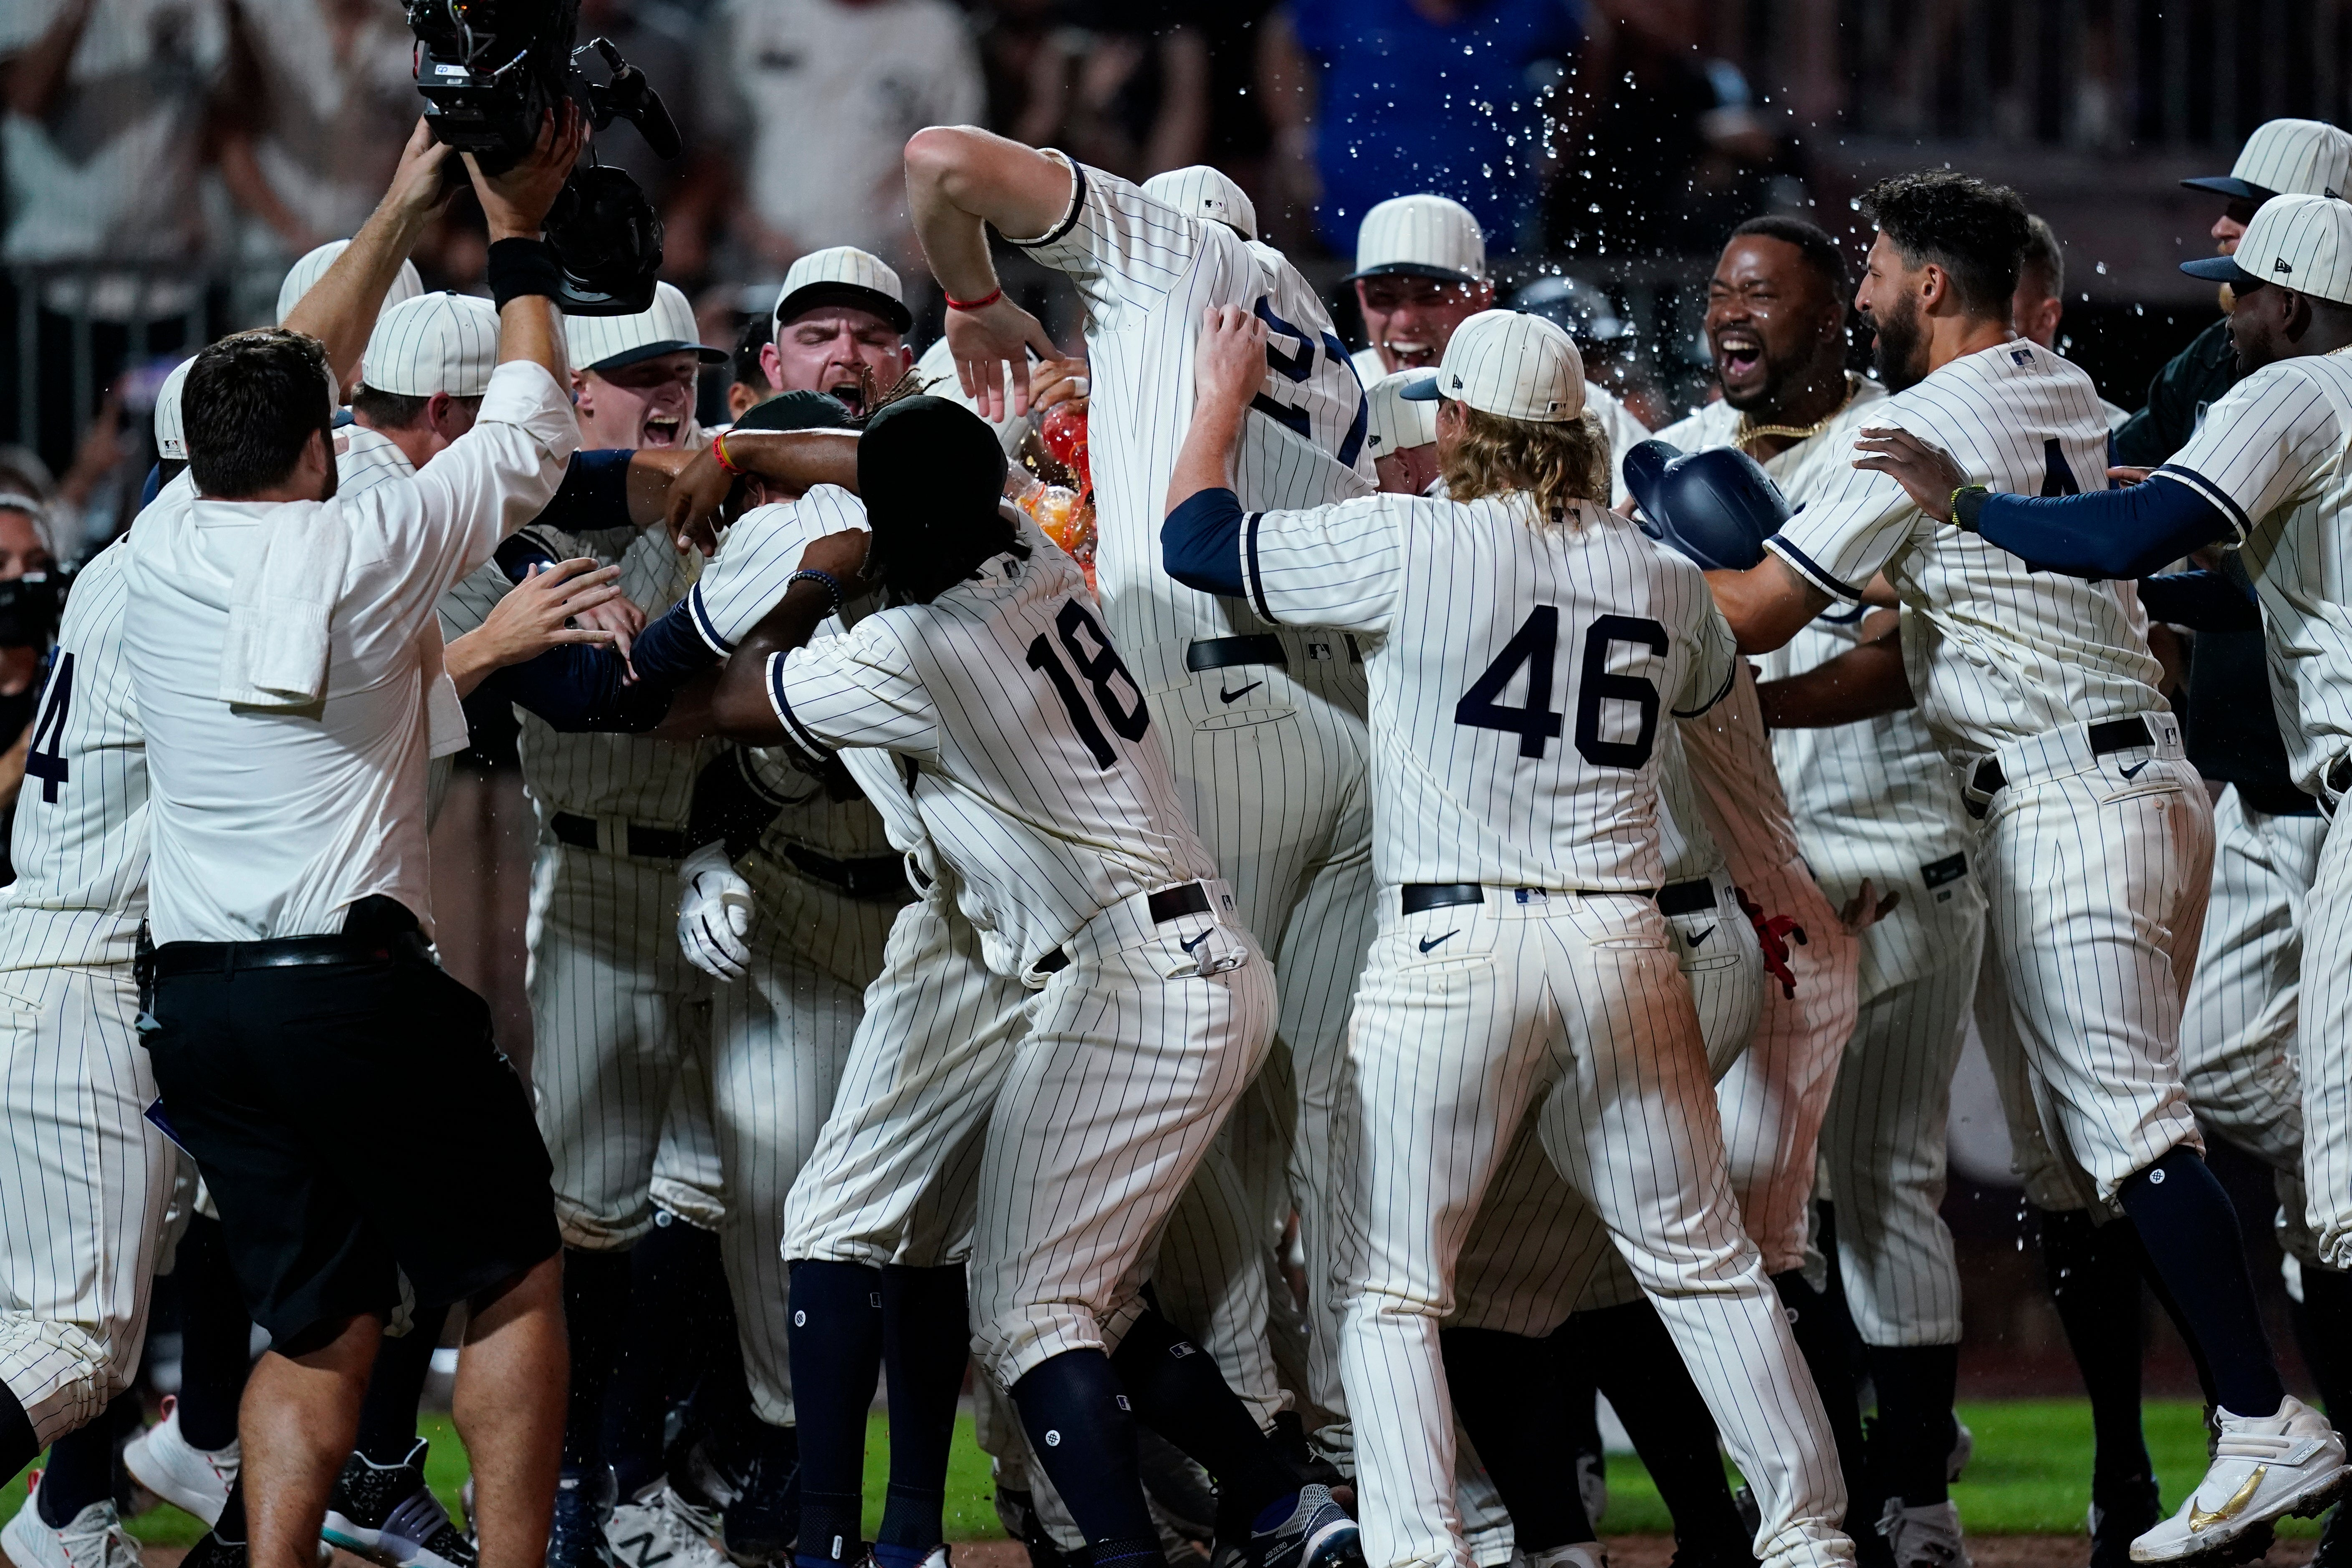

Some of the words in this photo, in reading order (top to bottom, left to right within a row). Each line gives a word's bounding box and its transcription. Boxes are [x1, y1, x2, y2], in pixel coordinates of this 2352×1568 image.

[25, 646, 74, 804] 4
[1026, 598, 1149, 771] 18
[1454, 605, 1670, 770] 46
[2291, 1443, 2315, 1464] TROUT
[1265, 1541, 1287, 1560] ADIZERO
